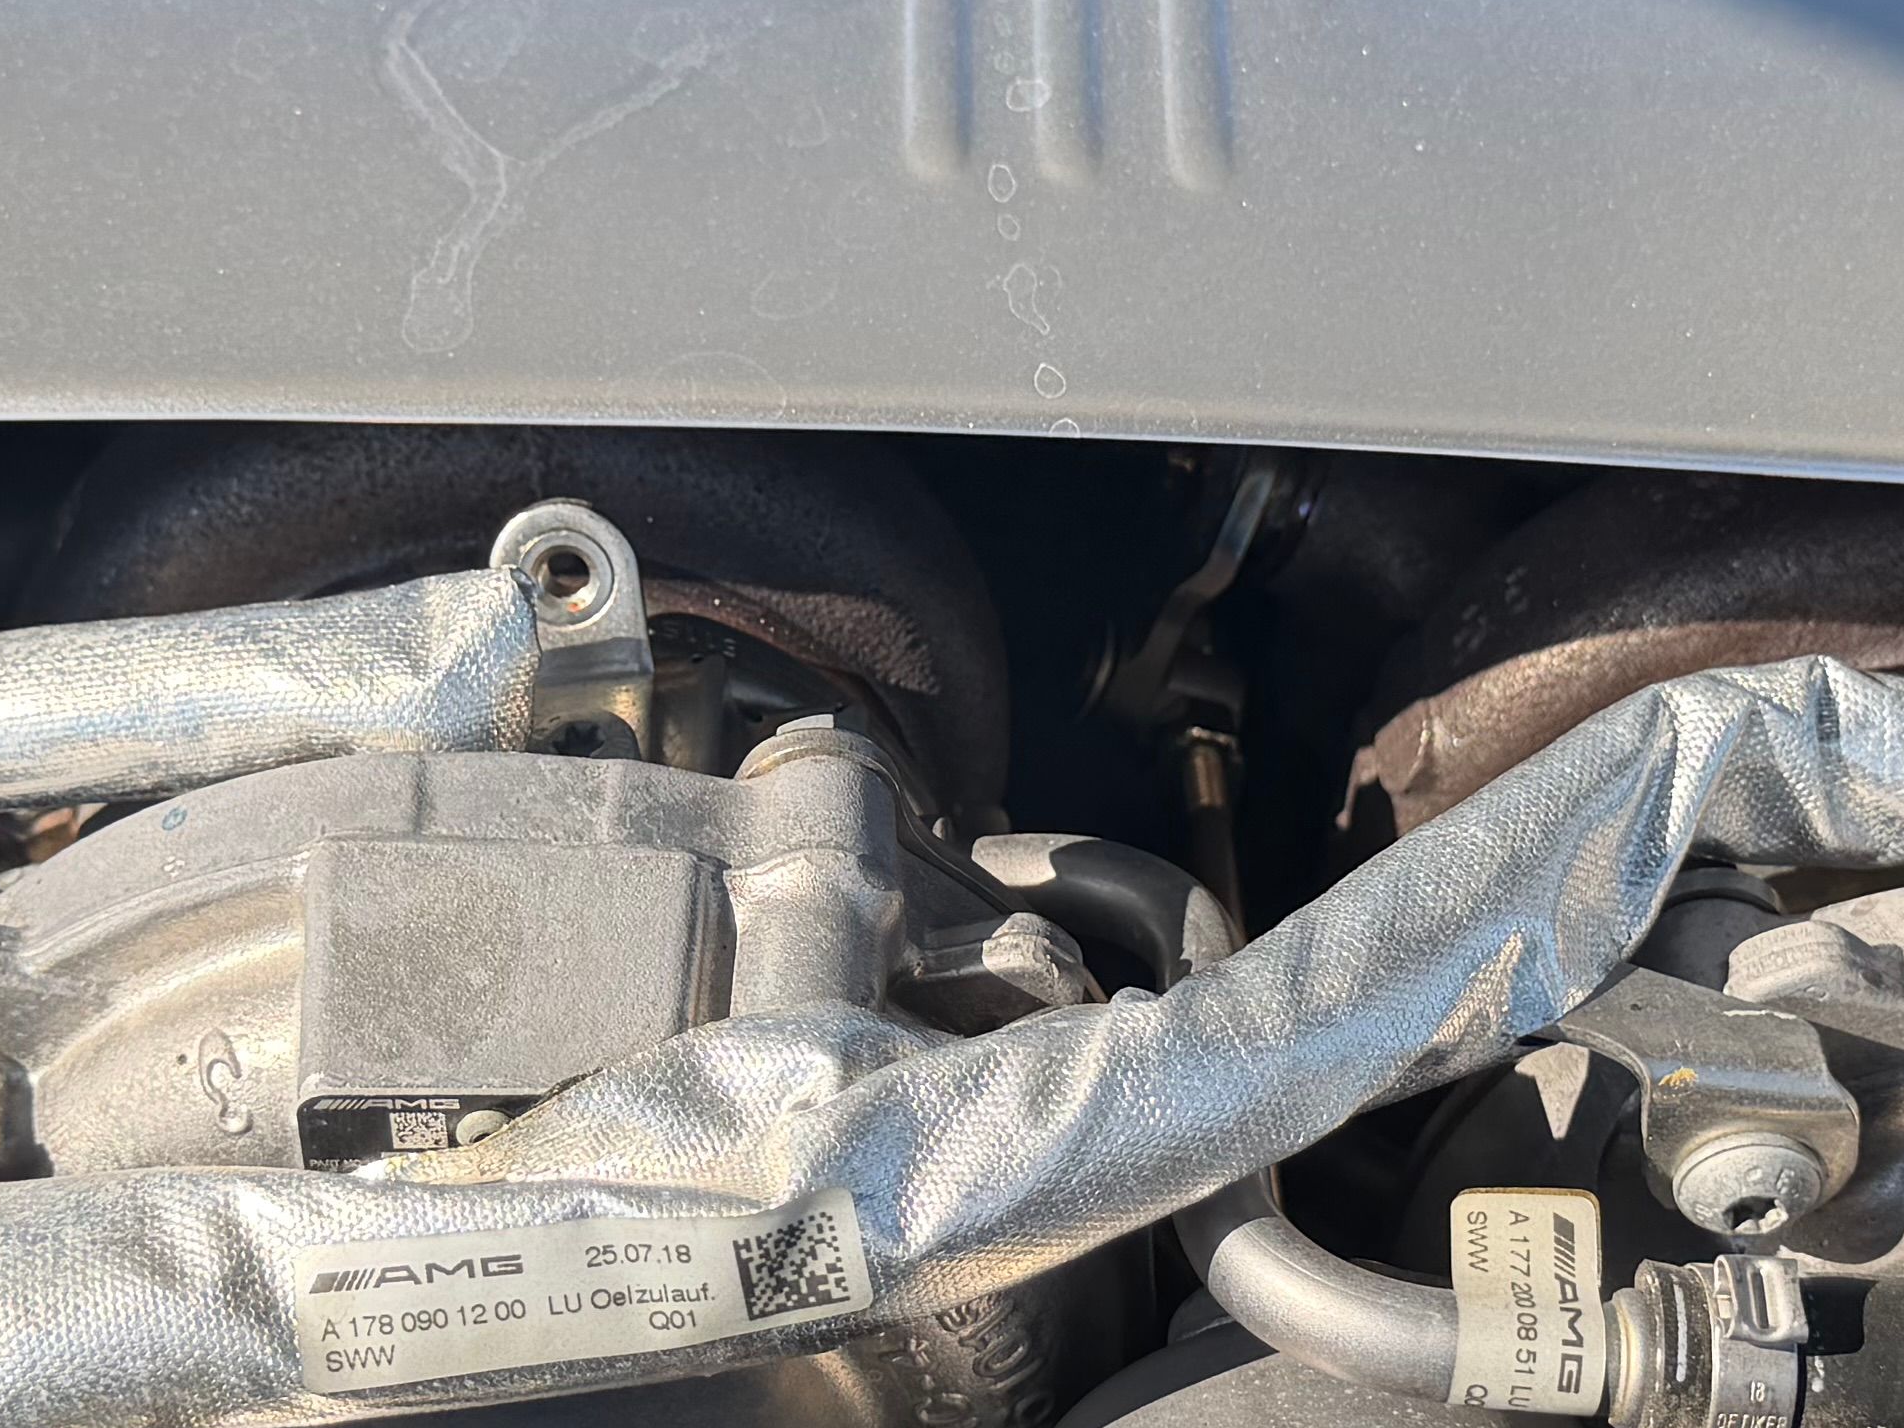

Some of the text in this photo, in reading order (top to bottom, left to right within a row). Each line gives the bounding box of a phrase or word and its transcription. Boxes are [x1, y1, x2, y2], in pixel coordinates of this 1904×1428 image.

[363, 1098, 460, 1110] AMG
[374, 1243, 693, 1287] AMG 25.07.18
[1466, 1209, 1489, 1273] SWW
[321, 1280, 717, 1342] A 178 090 12 00 LU Oelzulauf.
[647, 1310, 699, 1333] Q01
[1507, 1209, 1539, 1408] A 177 200 08 51 LU
[324, 1345, 396, 1373] SWW
[1553, 1280, 1585, 1395] AMG
